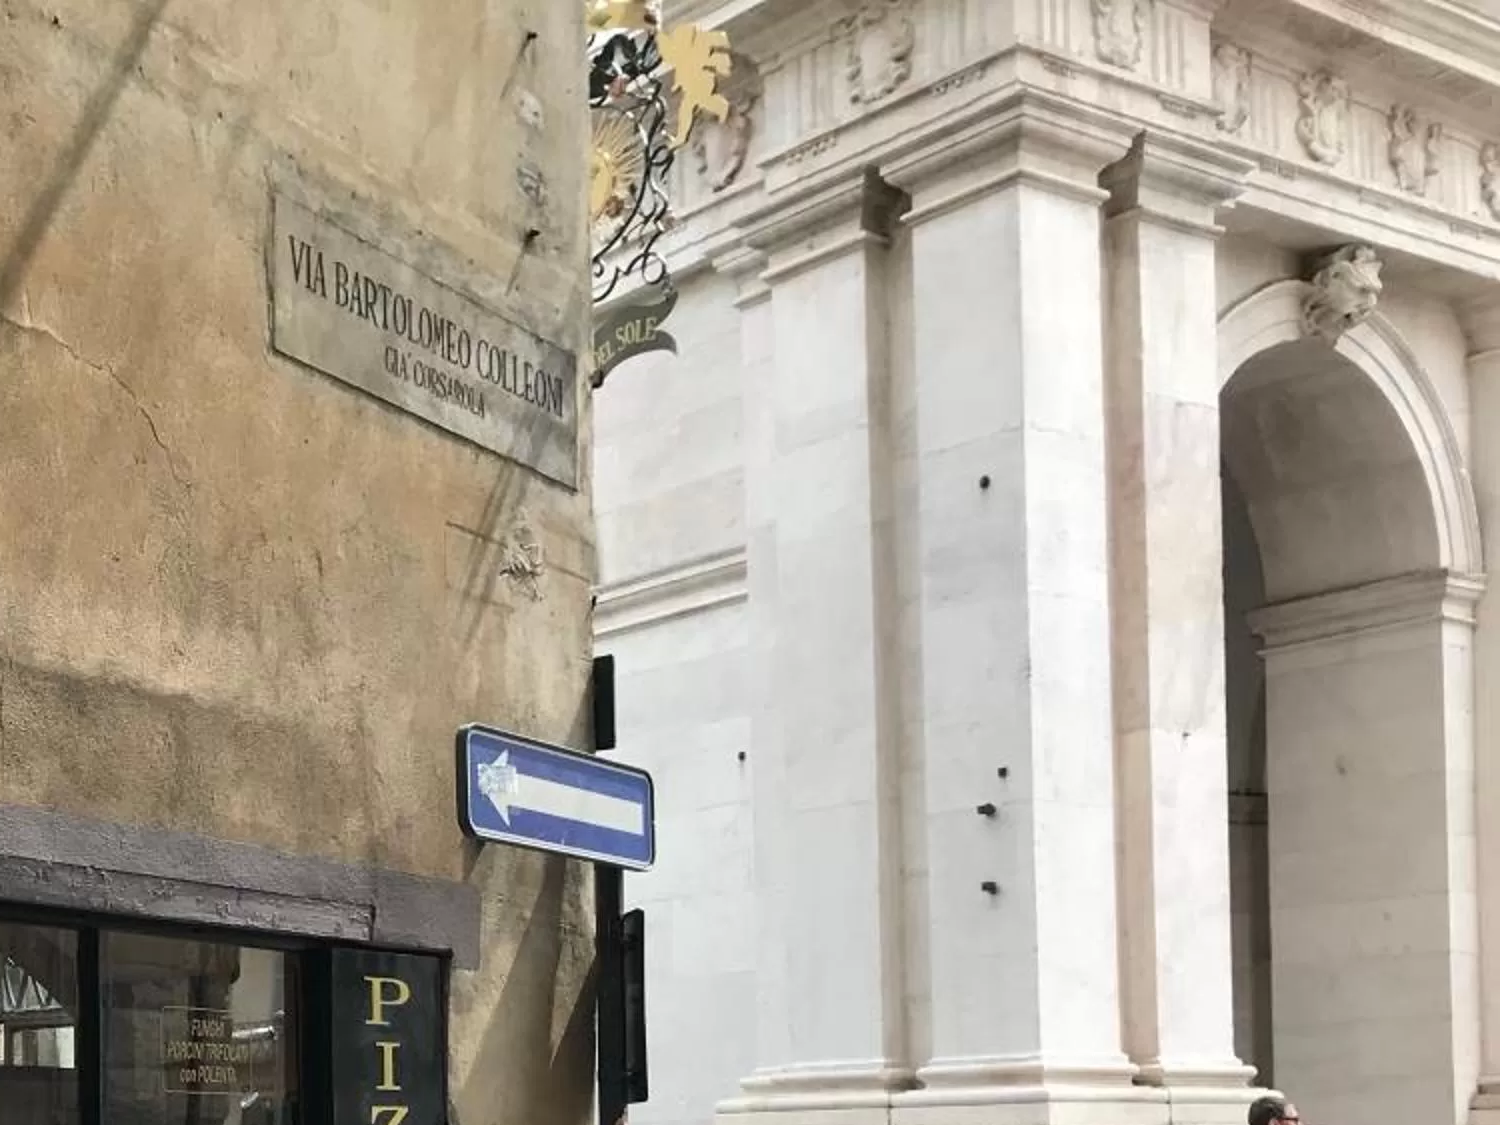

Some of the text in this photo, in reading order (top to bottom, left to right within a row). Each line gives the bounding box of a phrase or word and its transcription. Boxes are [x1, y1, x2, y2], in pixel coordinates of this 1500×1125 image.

[288, 235, 565, 418] VIA BARTOLOMEO COLLEONI
[615, 316, 658, 352] SOLE
